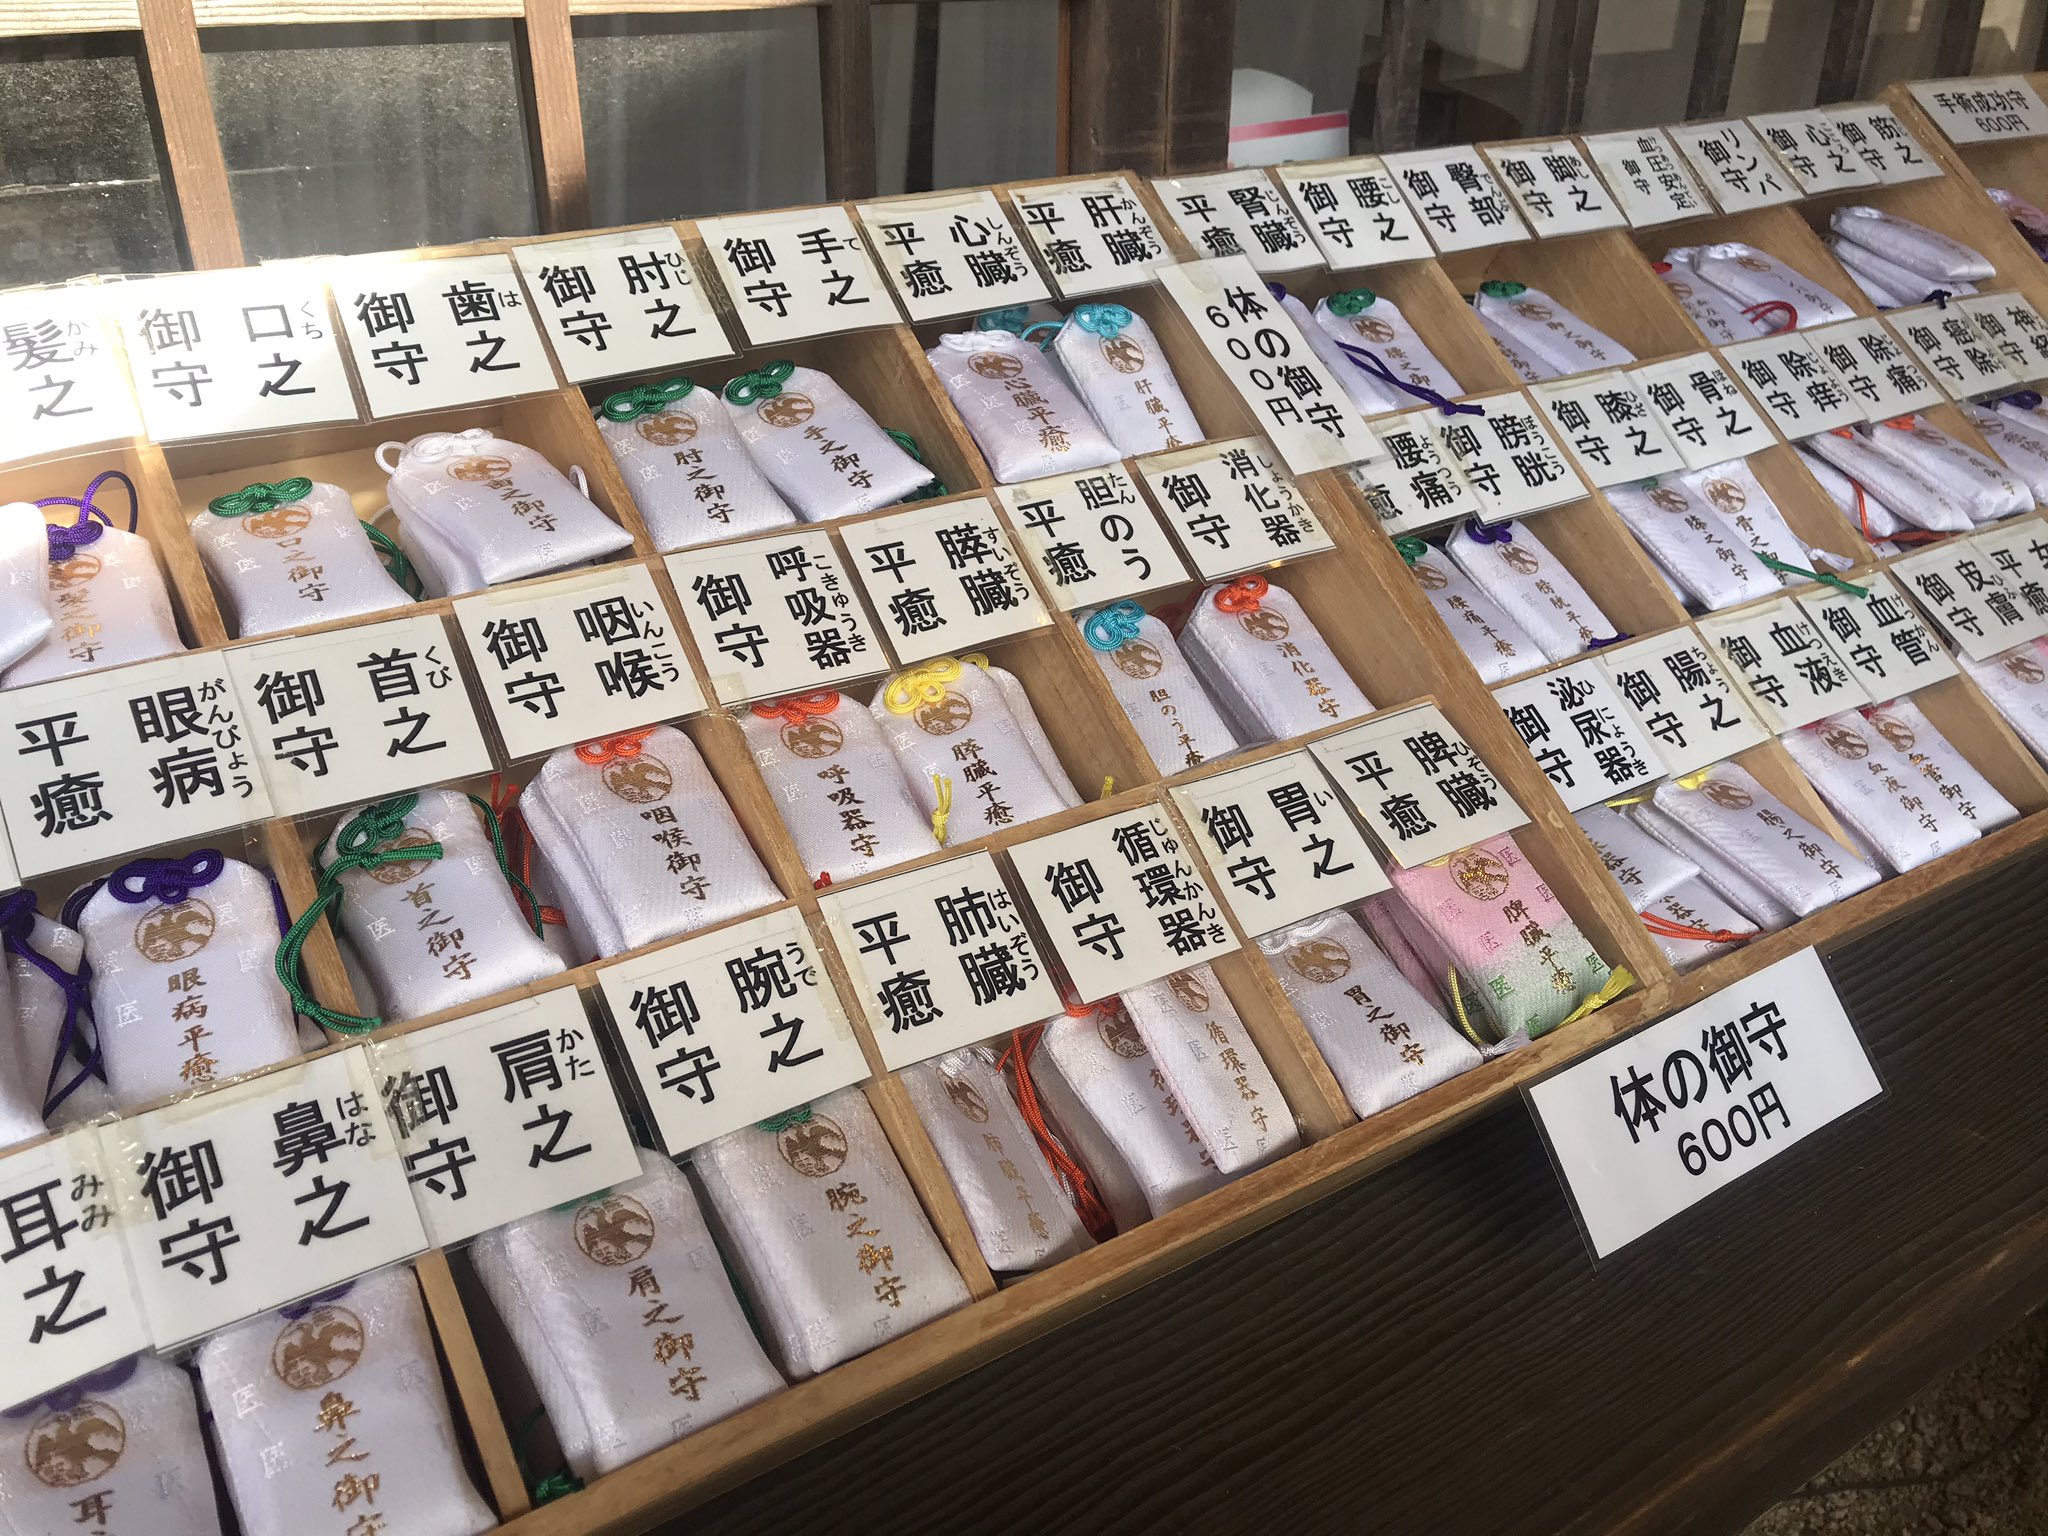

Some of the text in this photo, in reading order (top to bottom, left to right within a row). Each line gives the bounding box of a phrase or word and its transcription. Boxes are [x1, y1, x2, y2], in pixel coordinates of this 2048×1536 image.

[1933, 88, 2030, 114] 手術成功守
[1975, 114, 2030, 133] 600円
[1570, 156, 1590, 180] あし
[1621, 159, 1651, 196] 御守
[1637, 136, 1692, 211] 血圧安定
[1698, 139, 1750, 194] 御守
[1720, 127, 1783, 196] リンパ
[1766, 128, 1818, 179] 御守
[1805, 123, 1856, 173] 心之
[1836, 121, 1887, 172] 御守
[1868, 115, 1923, 165] 筋之
[1227, 186, 1299, 253] 腎臓
[1264, 191, 1306, 244] じんぞう
[1299, 181, 1354, 248] 御守
[1347, 176, 1408, 242] 腰之
[1379, 176, 1400, 204] こし
[1403, 169, 1457, 233] 御守
[1500, 158, 1554, 218] 御守
[1542, 154, 1602, 213] 脚之
[842, 238, 860, 251] て
[880, 221, 953, 298] 平癒
[949, 215, 1018, 287] 心臓
[986, 217, 1028, 276] しんぞう
[1022, 202, 1092, 274] 平癒
[1082, 195, 1152, 266] 肝臓
[1120, 198, 1162, 255] かんぞう
[1176, 194, 1247, 257] 平癒
[500, 289, 522, 308] は
[618, 251, 696, 340] 肘之
[665, 251, 691, 286] ひじ
[722, 238, 793, 317] 御守
[797, 228, 870, 306] 手之
[66, 320, 98, 358] かみ
[300, 301, 323, 340] くち
[353, 291, 428, 385] 御守
[441, 280, 520, 374] 歯之
[538, 265, 613, 351] 御守
[1974, 312, 2028, 365] 御守
[2, 318, 93, 421] 髪之
[137, 308, 212, 407] 御守
[241, 304, 315, 397] 口之
[1205, 304, 1303, 427] 600円
[1223, 285, 1346, 439] 体の御守
[1712, 370, 1738, 397] ほね
[1777, 350, 1842, 413] 除痒
[1823, 343, 1881, 402] 御守
[1858, 333, 1922, 396] 除痛
[1907, 326, 1965, 381] 御守
[1594, 390, 1662, 457] 膝之
[1624, 391, 1647, 418] ひざ
[1647, 382, 1708, 447] 御守
[1688, 371, 1752, 437] 骨之
[1741, 359, 1800, 419] 御守
[803, 425, 874, 488] 手之御守
[1420, 434, 1462, 496] ようつう
[1440, 424, 1501, 496] 御守
[1487, 414, 1558, 488] 膀胱
[1551, 399, 1612, 466] 御守
[673, 448, 735, 524] 肘之御守
[1107, 472, 1135, 505] たん
[1219, 448, 1301, 549] 消化器
[1255, 455, 1314, 534] しょうかき
[1386, 431, 1454, 510] 腰痛
[1018, 499, 1097, 586] 平癒
[1074, 476, 1151, 581] 胆のう
[1161, 473, 1232, 550] 御守
[865, 540, 948, 637] 平癒
[935, 522, 1019, 617] 膵臓
[986, 525, 1030, 601] すいぞう
[1954, 559, 2024, 627] 皮膚
[691, 574, 770, 669] 御守
[766, 546, 852, 671] 呼吸器
[813, 554, 867, 653] こきゅうき
[1866, 592, 1932, 667] 血管
[1915, 572, 1985, 637] 御守
[424, 645, 453, 689] くび
[482, 617, 566, 719] 御守
[573, 596, 665, 700] 咽喉
[631, 600, 680, 683] いんこう
[1691, 646, 1730, 694] ちょう
[1720, 634, 1789, 708] 御守
[1768, 620, 1843, 696] 血液
[1798, 620, 1849, 683] けつえき
[1822, 606, 1887, 679] 御守
[253, 669, 339, 778] 御守
[356, 648, 447, 758] 首之
[1616, 669, 1688, 749] 御守
[1662, 649, 1741, 731] 腸之
[128, 686, 225, 809] 眼病
[198, 678, 254, 799] がんびょう
[1503, 703, 1574, 789] 御守
[1546, 676, 1636, 786] 泌尿器
[1583, 679, 1650, 777] ひにょうき
[15, 711, 114, 838] 平癒
[1314, 790, 1333, 807] い
[1344, 750, 1437, 842] 平癒
[1402, 726, 1498, 819] 脾臓
[1451, 741, 1498, 794] ひぞう
[817, 763, 880, 857] 呼吸器守
[1267, 781, 1355, 880] 胃之
[1111, 820, 1210, 957] 循環器
[1148, 817, 1226, 944] じゅんかんき
[1200, 803, 1277, 902] 御守
[400, 881, 478, 980] 首之御守
[934, 886, 1027, 1007] 肺臓
[987, 889, 1039, 981] はいぞう
[1044, 858, 1126, 961] 御守
[786, 941, 818, 987] うで
[852, 911, 944, 1034] 平癒
[629, 980, 721, 1104] 御守
[725, 946, 823, 1073] 腕之
[556, 1027, 595, 1081] かた
[1610, 1001, 1790, 1144] 体の御守
[336, 1091, 376, 1148] はな
[381, 1065, 476, 1201] 御守
[490, 1029, 592, 1169] 肩之
[1677, 1082, 1791, 1176] 600円
[71, 1173, 115, 1233] みみ
[273, 1099, 370, 1246] 鼻之
[136, 1139, 240, 1285] 御守
[0, 1178, 107, 1344] 耳之
[628, 1265, 707, 1401] 肩之御守
